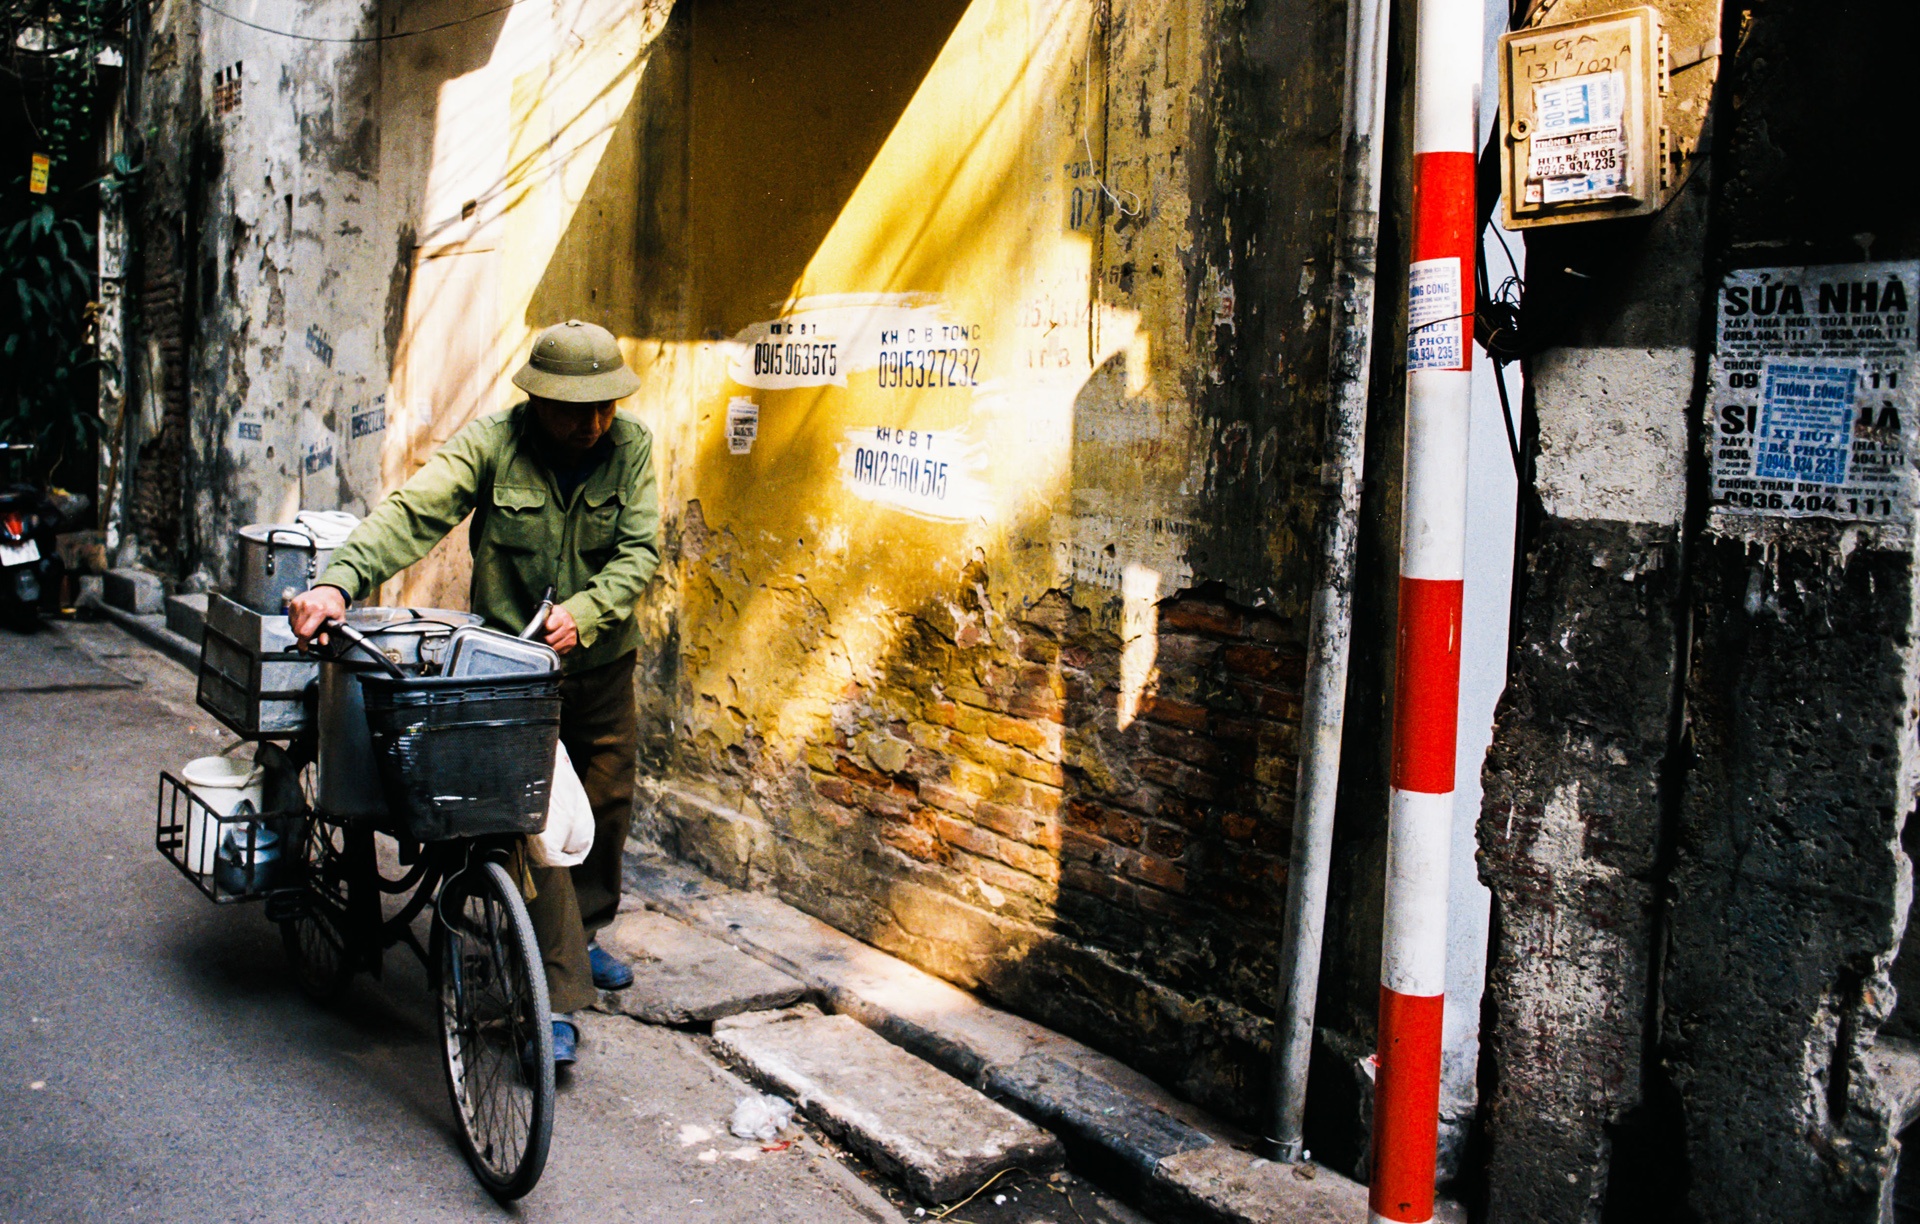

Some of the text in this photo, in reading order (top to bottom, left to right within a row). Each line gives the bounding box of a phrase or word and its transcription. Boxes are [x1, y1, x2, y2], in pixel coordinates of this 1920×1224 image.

[1724, 272, 1909, 316] SỬA NHÀ
[1776, 381, 1811, 398] THÔNG
[1773, 429, 1795, 440] XE
[1815, 458, 1836, 475] 235
